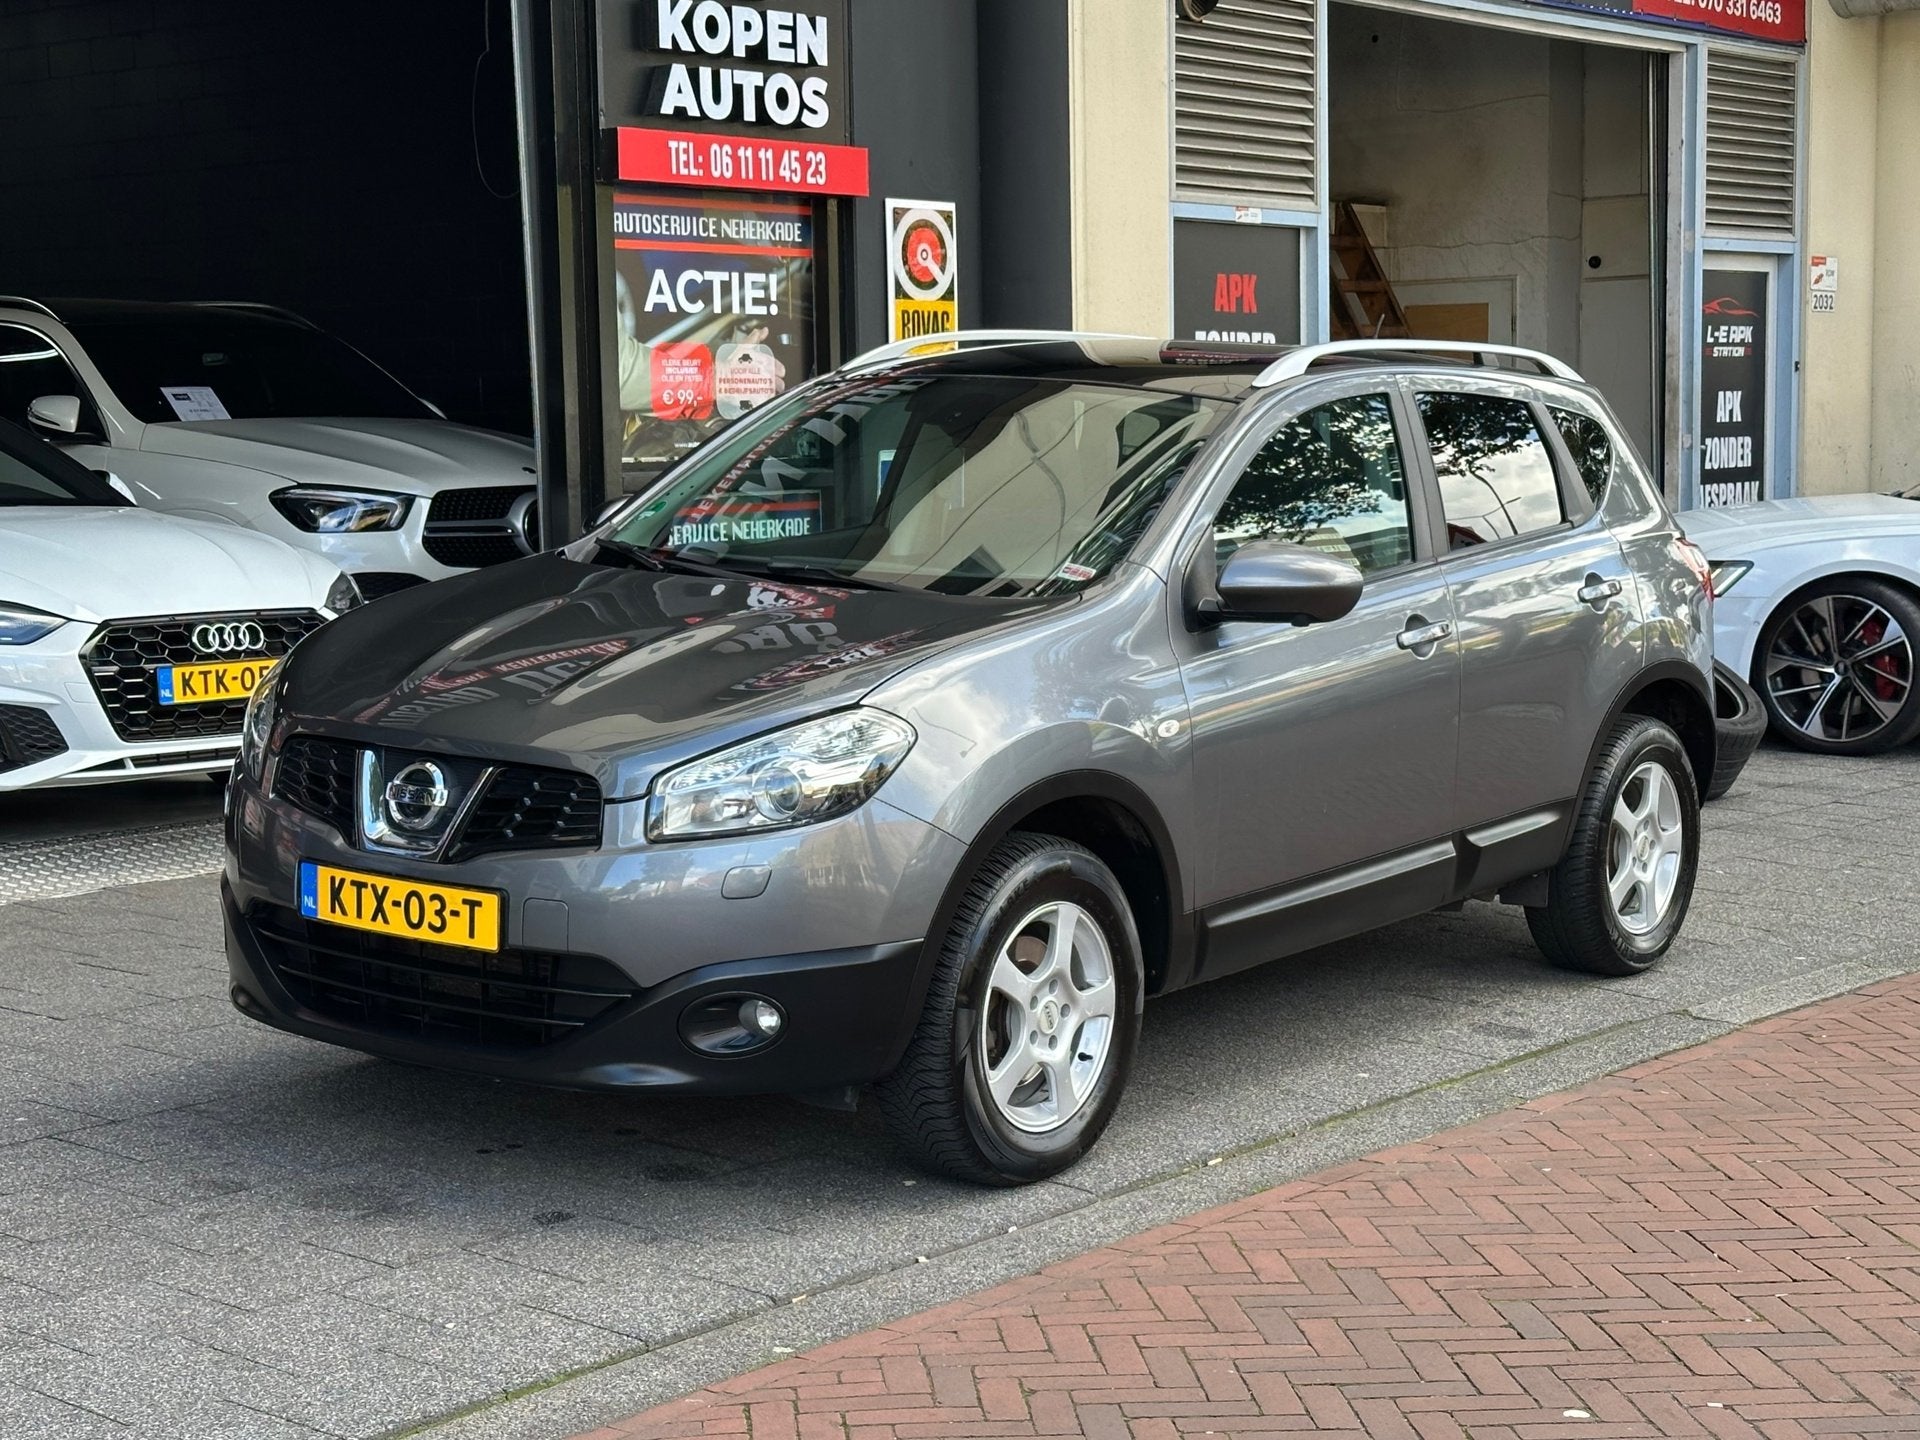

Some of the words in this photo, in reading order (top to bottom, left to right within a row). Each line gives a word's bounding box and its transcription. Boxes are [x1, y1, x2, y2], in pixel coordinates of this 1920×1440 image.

[1750, 2, 1782, 24] 6463
[658, 0, 828, 66] KOPEN
[659, 63, 830, 129] AUTOS
[668, 140, 704, 177] TEL:
[710, 143, 733, 179] 06
[738, 146, 754, 180] 11
[758, 148, 774, 182] 11
[779, 149, 802, 184] 45
[806, 150, 827, 186] 23
[613, 211, 718, 238] AUTOSERVICE
[721, 217, 802, 242] NEHERKADE
[644, 268, 779, 316] ACTIE!
[1214, 273, 1258, 314] APK
[1813, 294, 1834, 310] 2032
[1729, 326, 1753, 343] APK
[1712, 346, 1746, 357] STATION
[1716, 390, 1742, 423] APK
[1704, 436, 1752, 470] ZONDER
[731, 517, 811, 541] NEHERKADE
[161, 688, 172, 698] NL
[390, 783, 435, 804] NISSAN
[304, 895, 316, 909] NL
[329, 875, 483, 940] KTX-03-T
